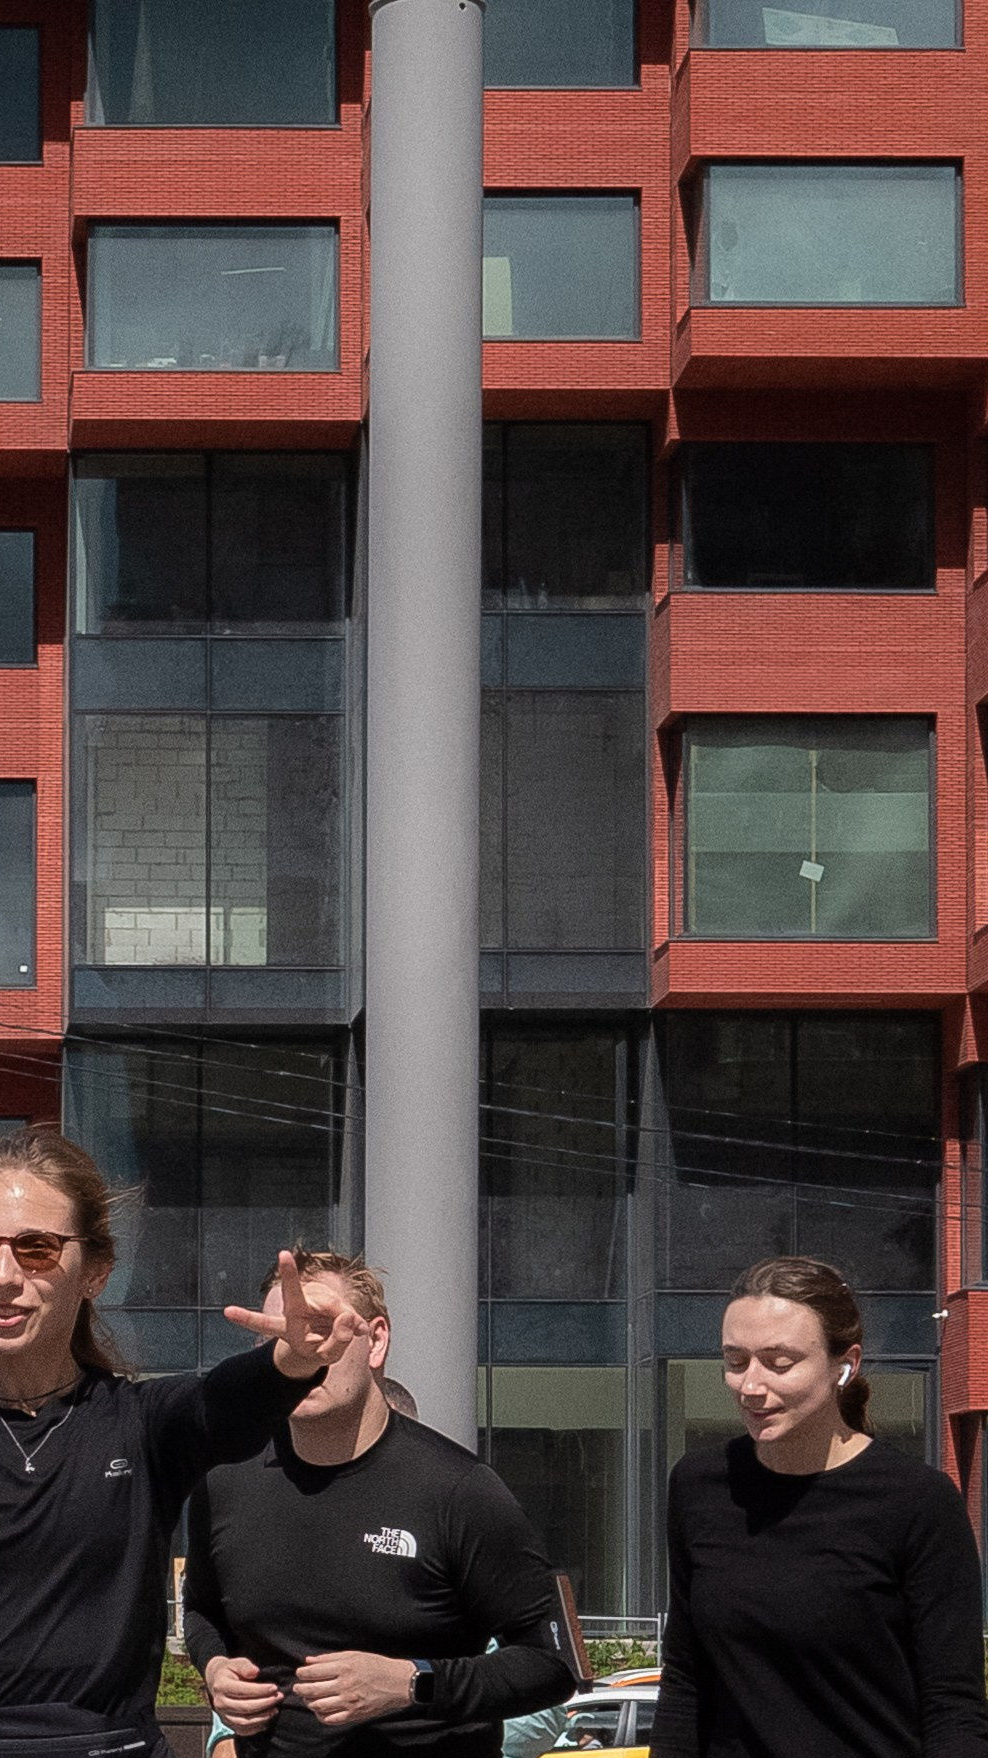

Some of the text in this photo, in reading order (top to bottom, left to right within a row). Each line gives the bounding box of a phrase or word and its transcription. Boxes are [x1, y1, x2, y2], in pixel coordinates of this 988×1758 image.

[380, 1526, 401, 1537] THE
[364, 1533, 399, 1546] NORTH
[372, 1543, 398, 1555] FACE
